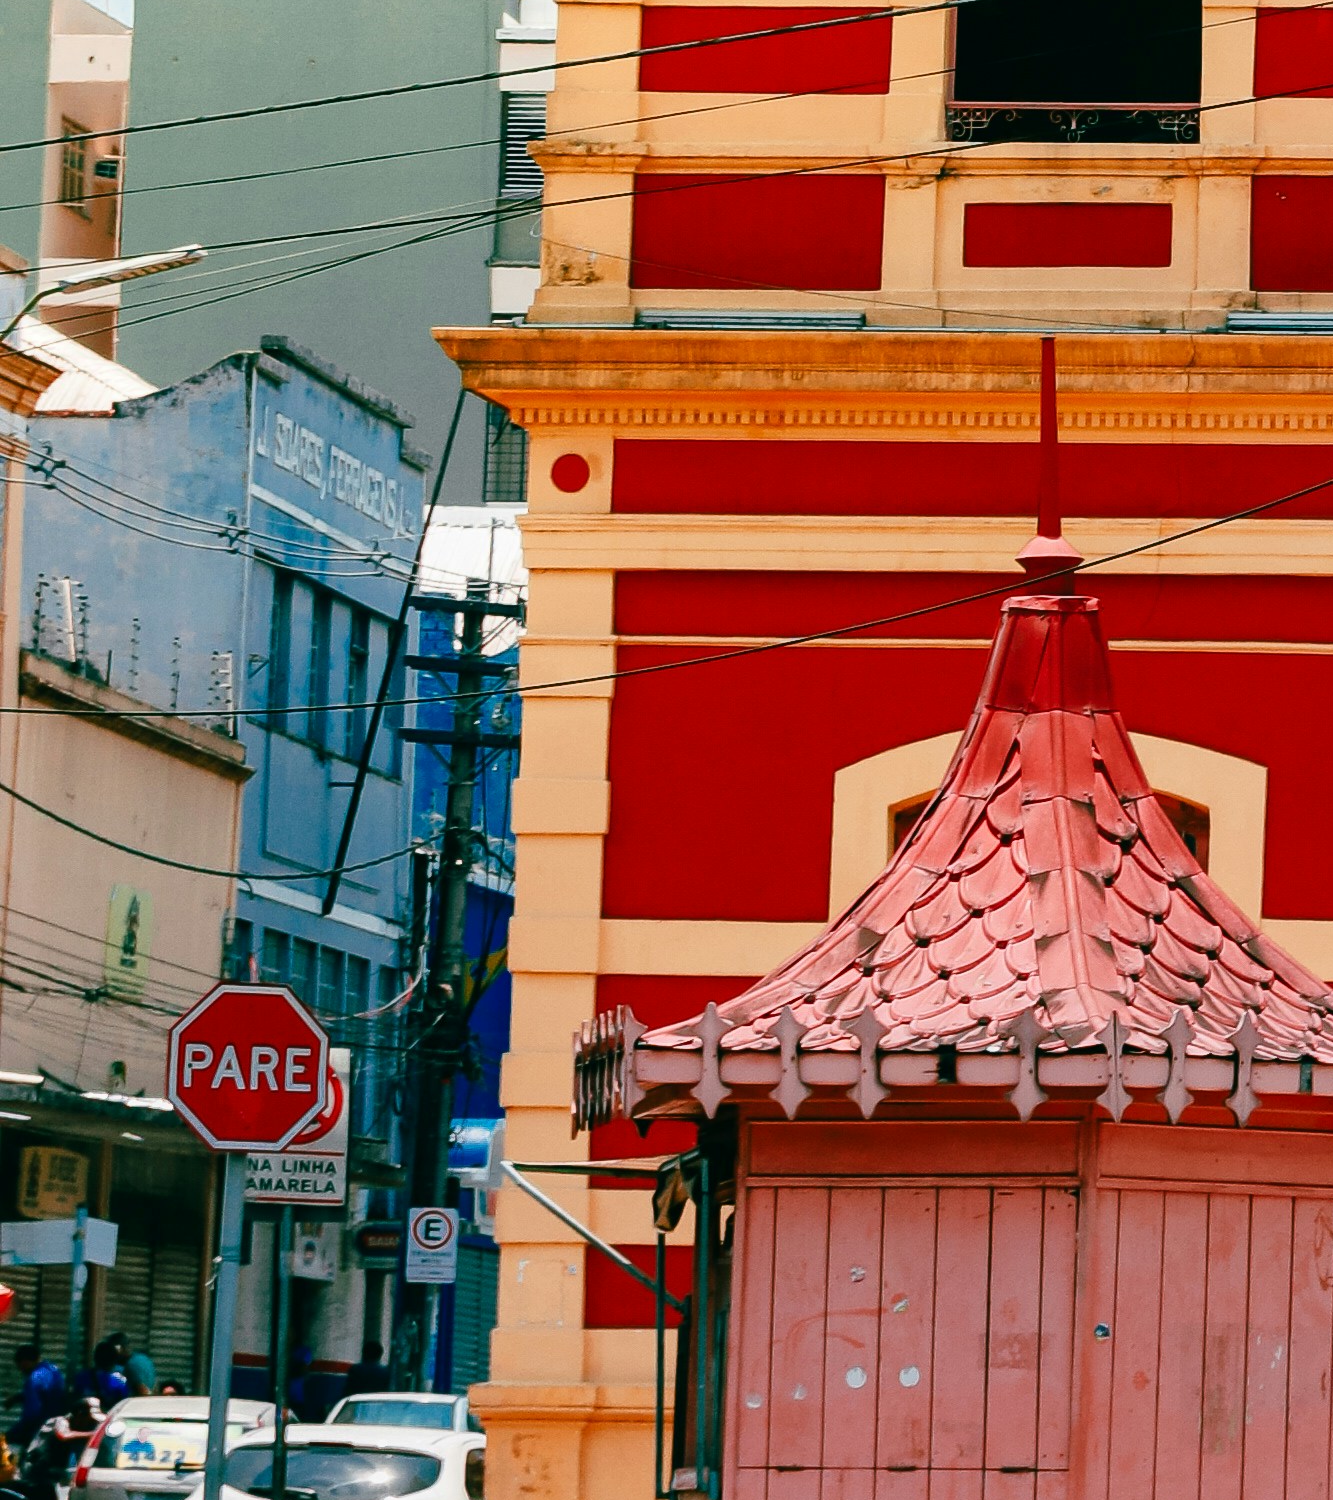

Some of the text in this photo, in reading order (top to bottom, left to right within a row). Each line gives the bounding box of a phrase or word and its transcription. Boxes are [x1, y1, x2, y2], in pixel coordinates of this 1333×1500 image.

[183, 1042, 312, 1093] PARE
[247, 1158, 337, 1174] NA LINHA
[246, 1176, 336, 1193] AMARELA
[424, 1218, 442, 1241] E
